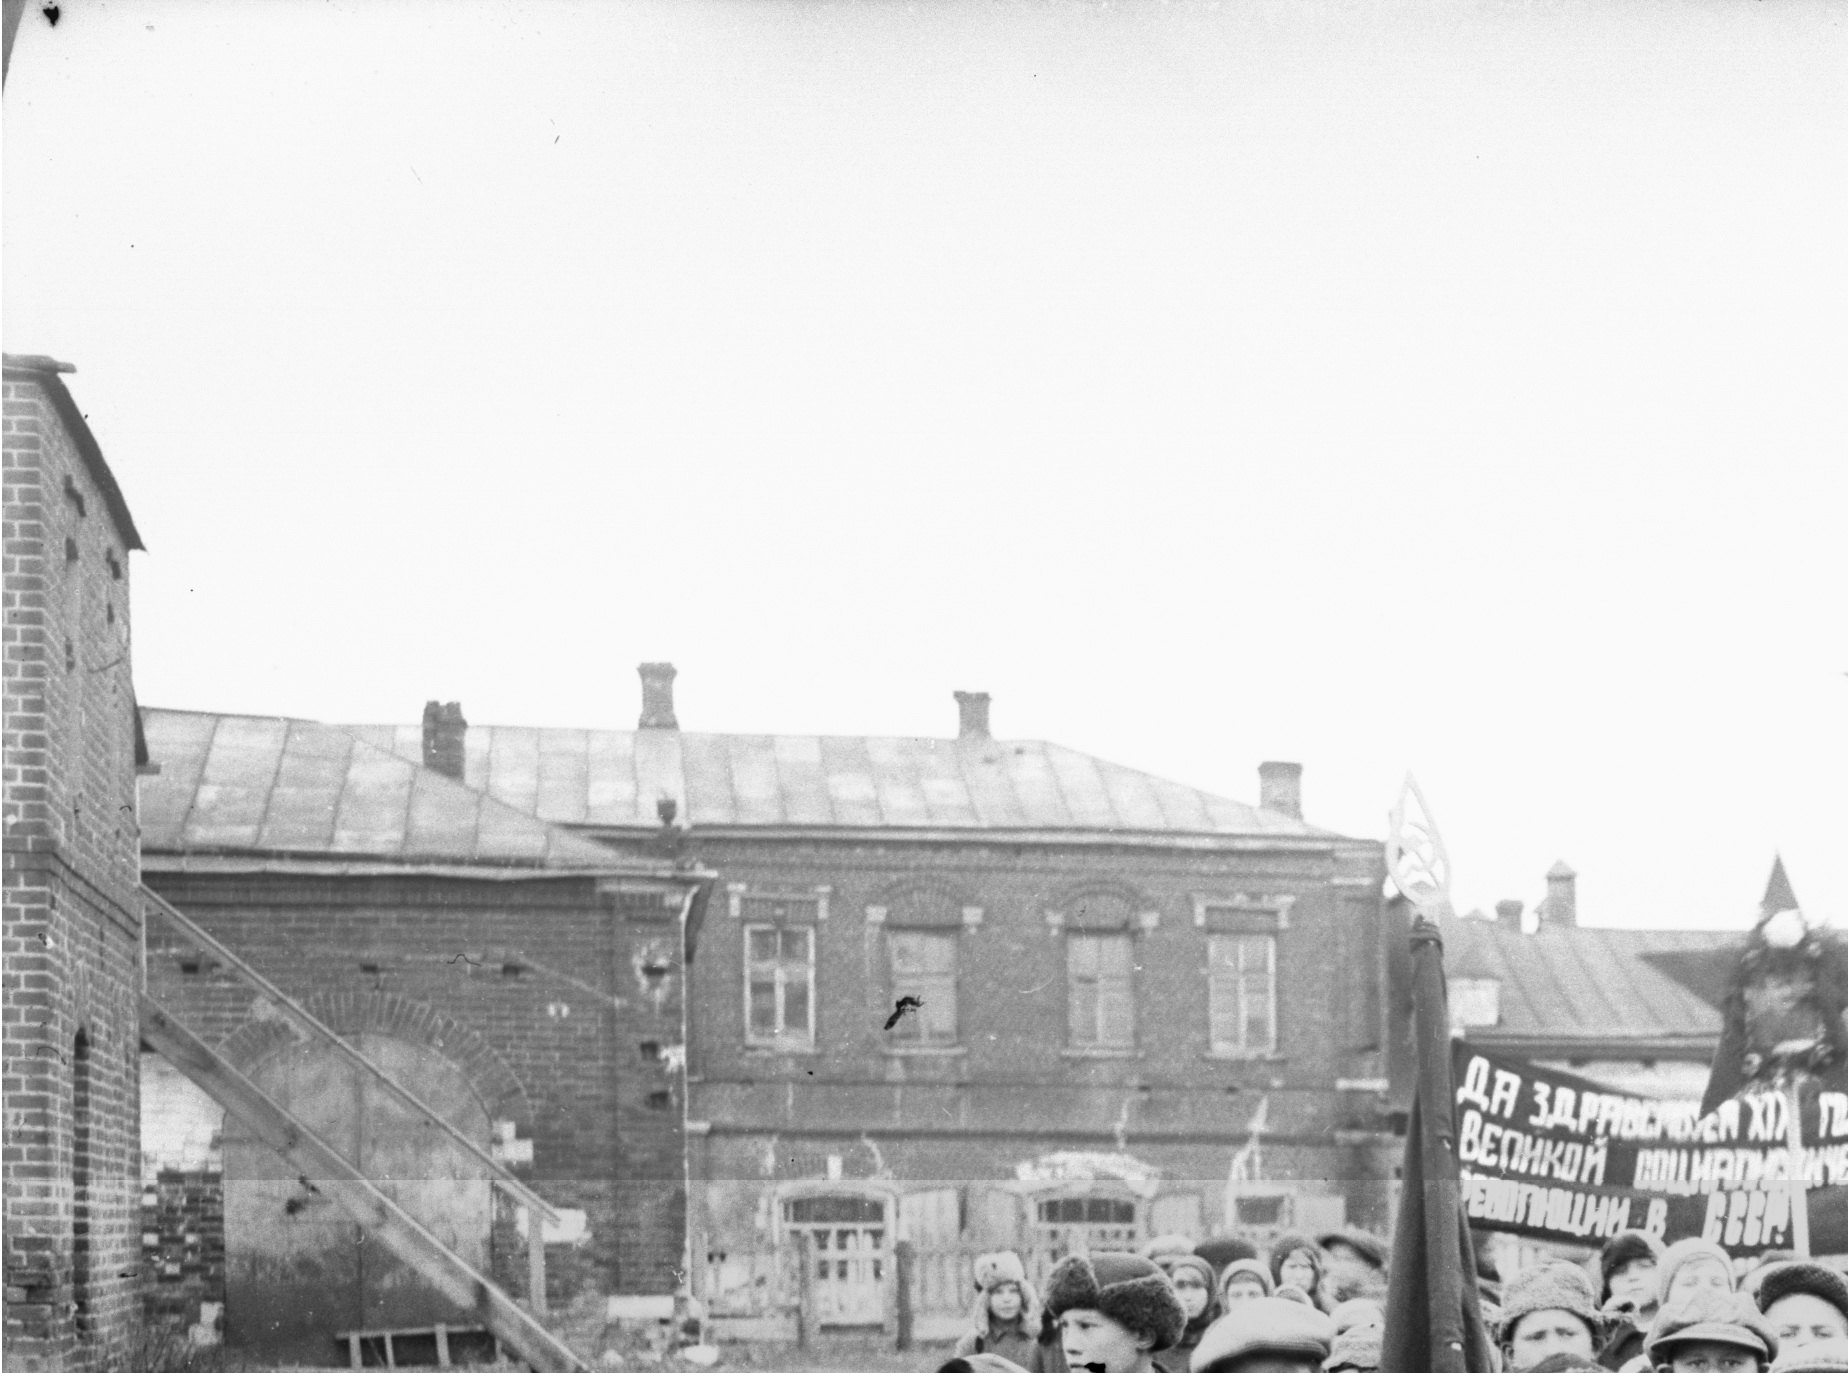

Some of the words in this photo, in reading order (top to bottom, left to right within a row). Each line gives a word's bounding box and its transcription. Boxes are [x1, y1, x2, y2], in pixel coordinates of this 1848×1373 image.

[1456, 1055, 1522, 1118] ДА
[1459, 1109, 1609, 1185] ВЕЛИКОЙ
[1646, 1199, 1668, 1240] В
